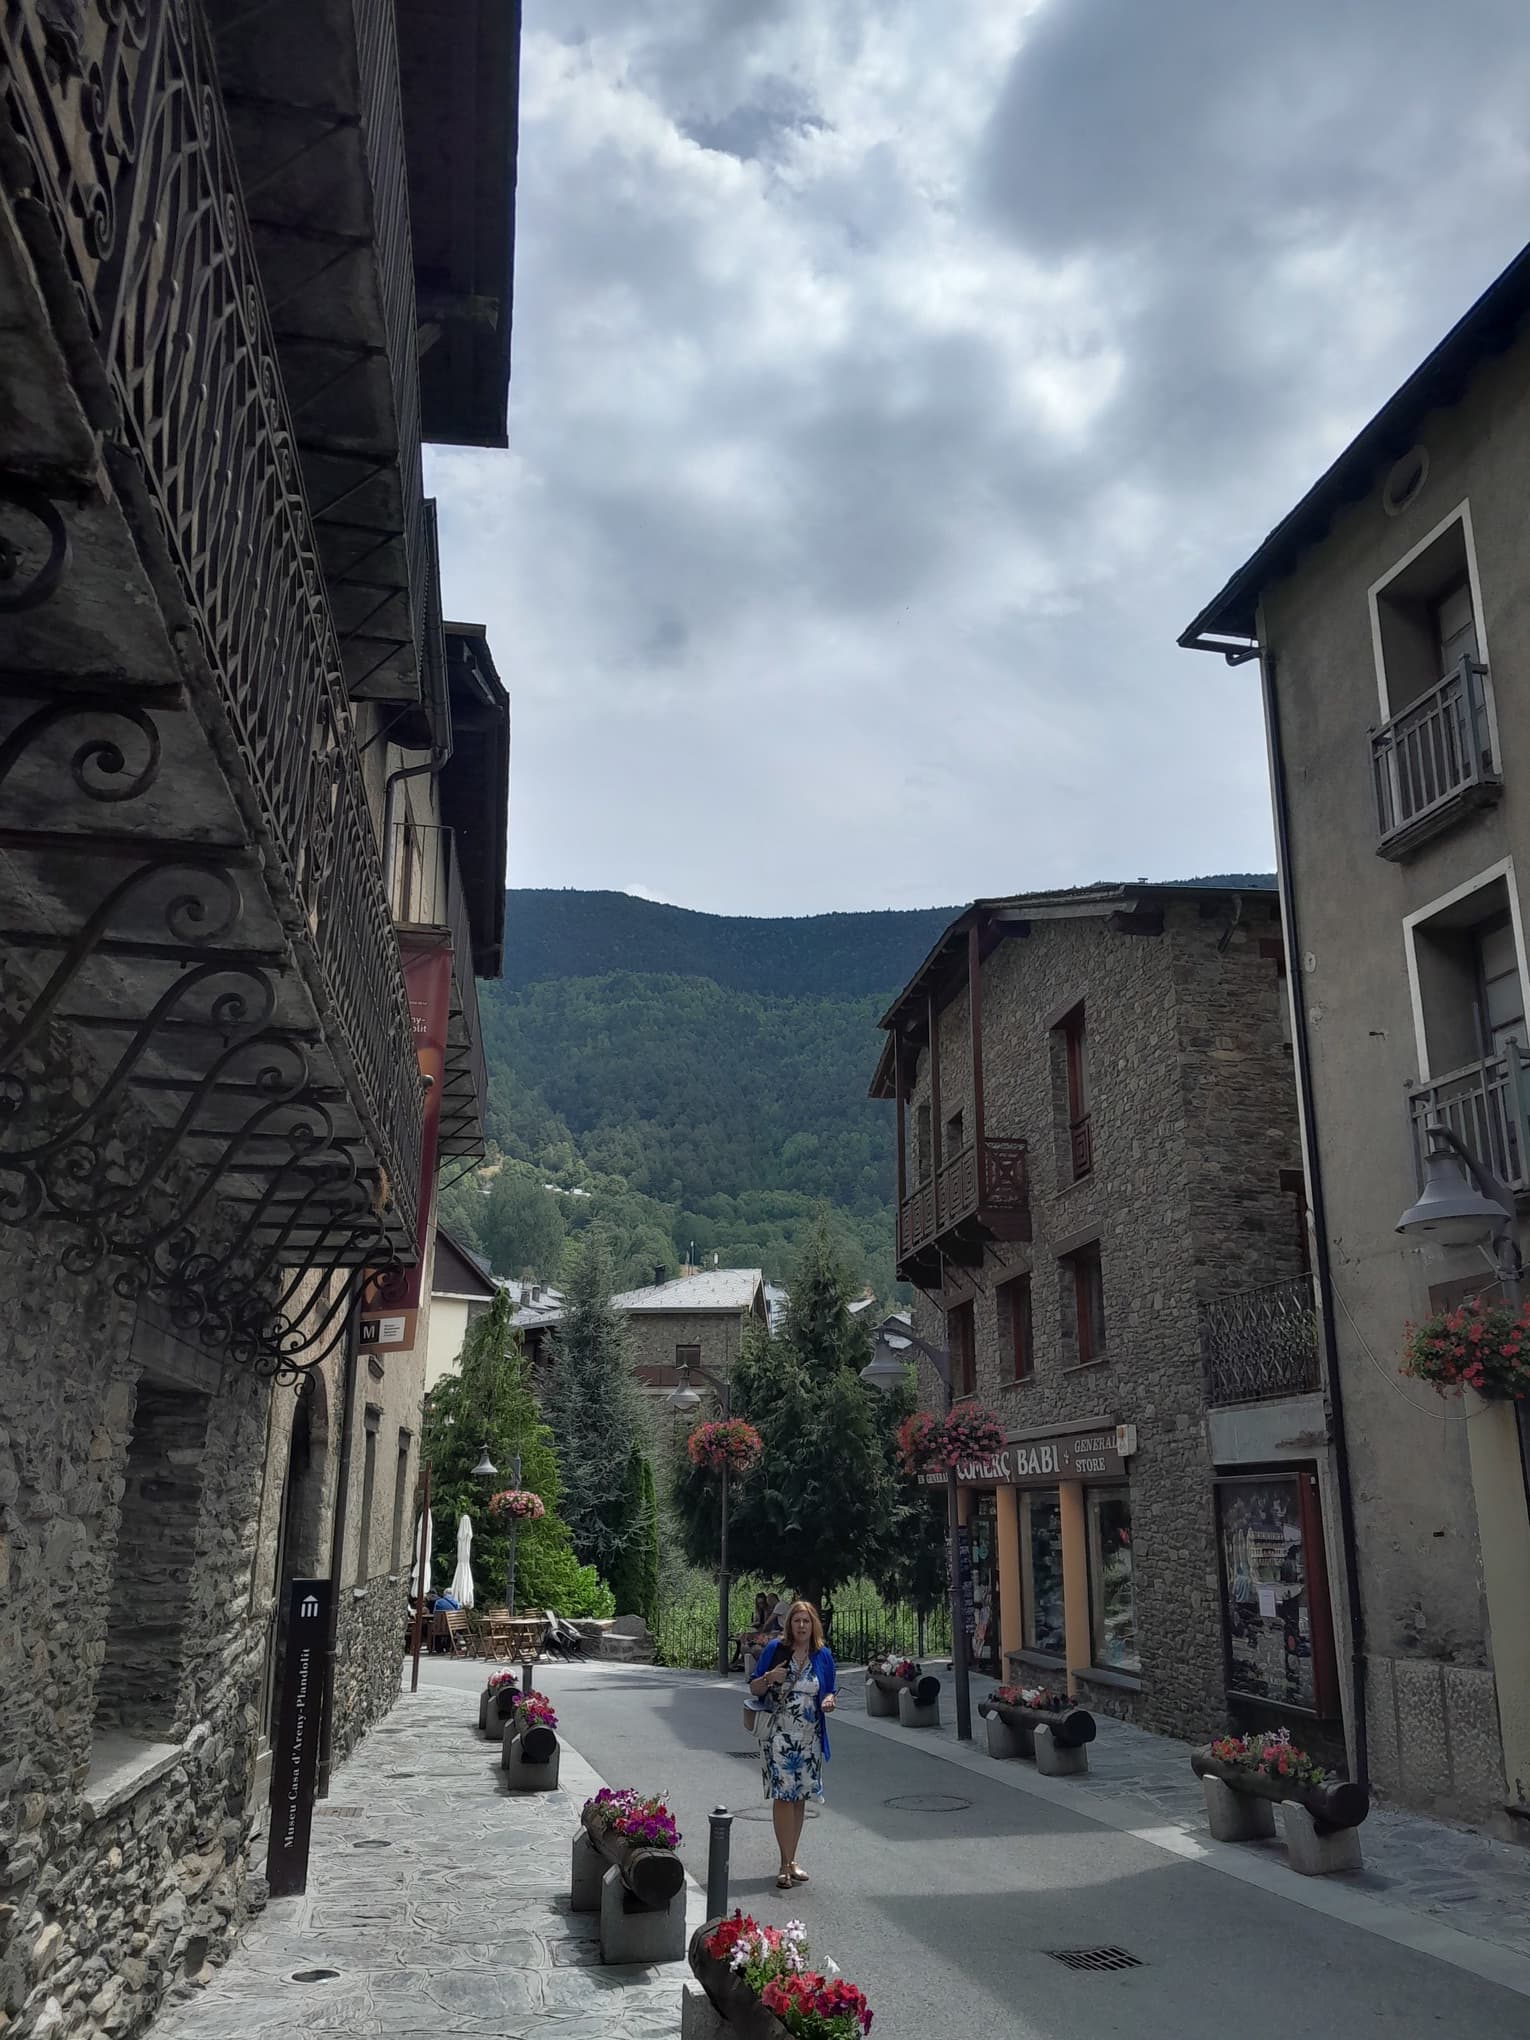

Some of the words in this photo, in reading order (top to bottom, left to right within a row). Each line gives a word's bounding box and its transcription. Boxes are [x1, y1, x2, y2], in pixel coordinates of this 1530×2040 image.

[363, 1325, 376, 1339] M
[1074, 1435, 1118, 1453] GENERAL
[1016, 1445, 1060, 1475] BABI
[1075, 1457, 1106, 1473] STORE
[288, 1769, 300, 1800] Casa
[284, 1804, 297, 1848] Museu
